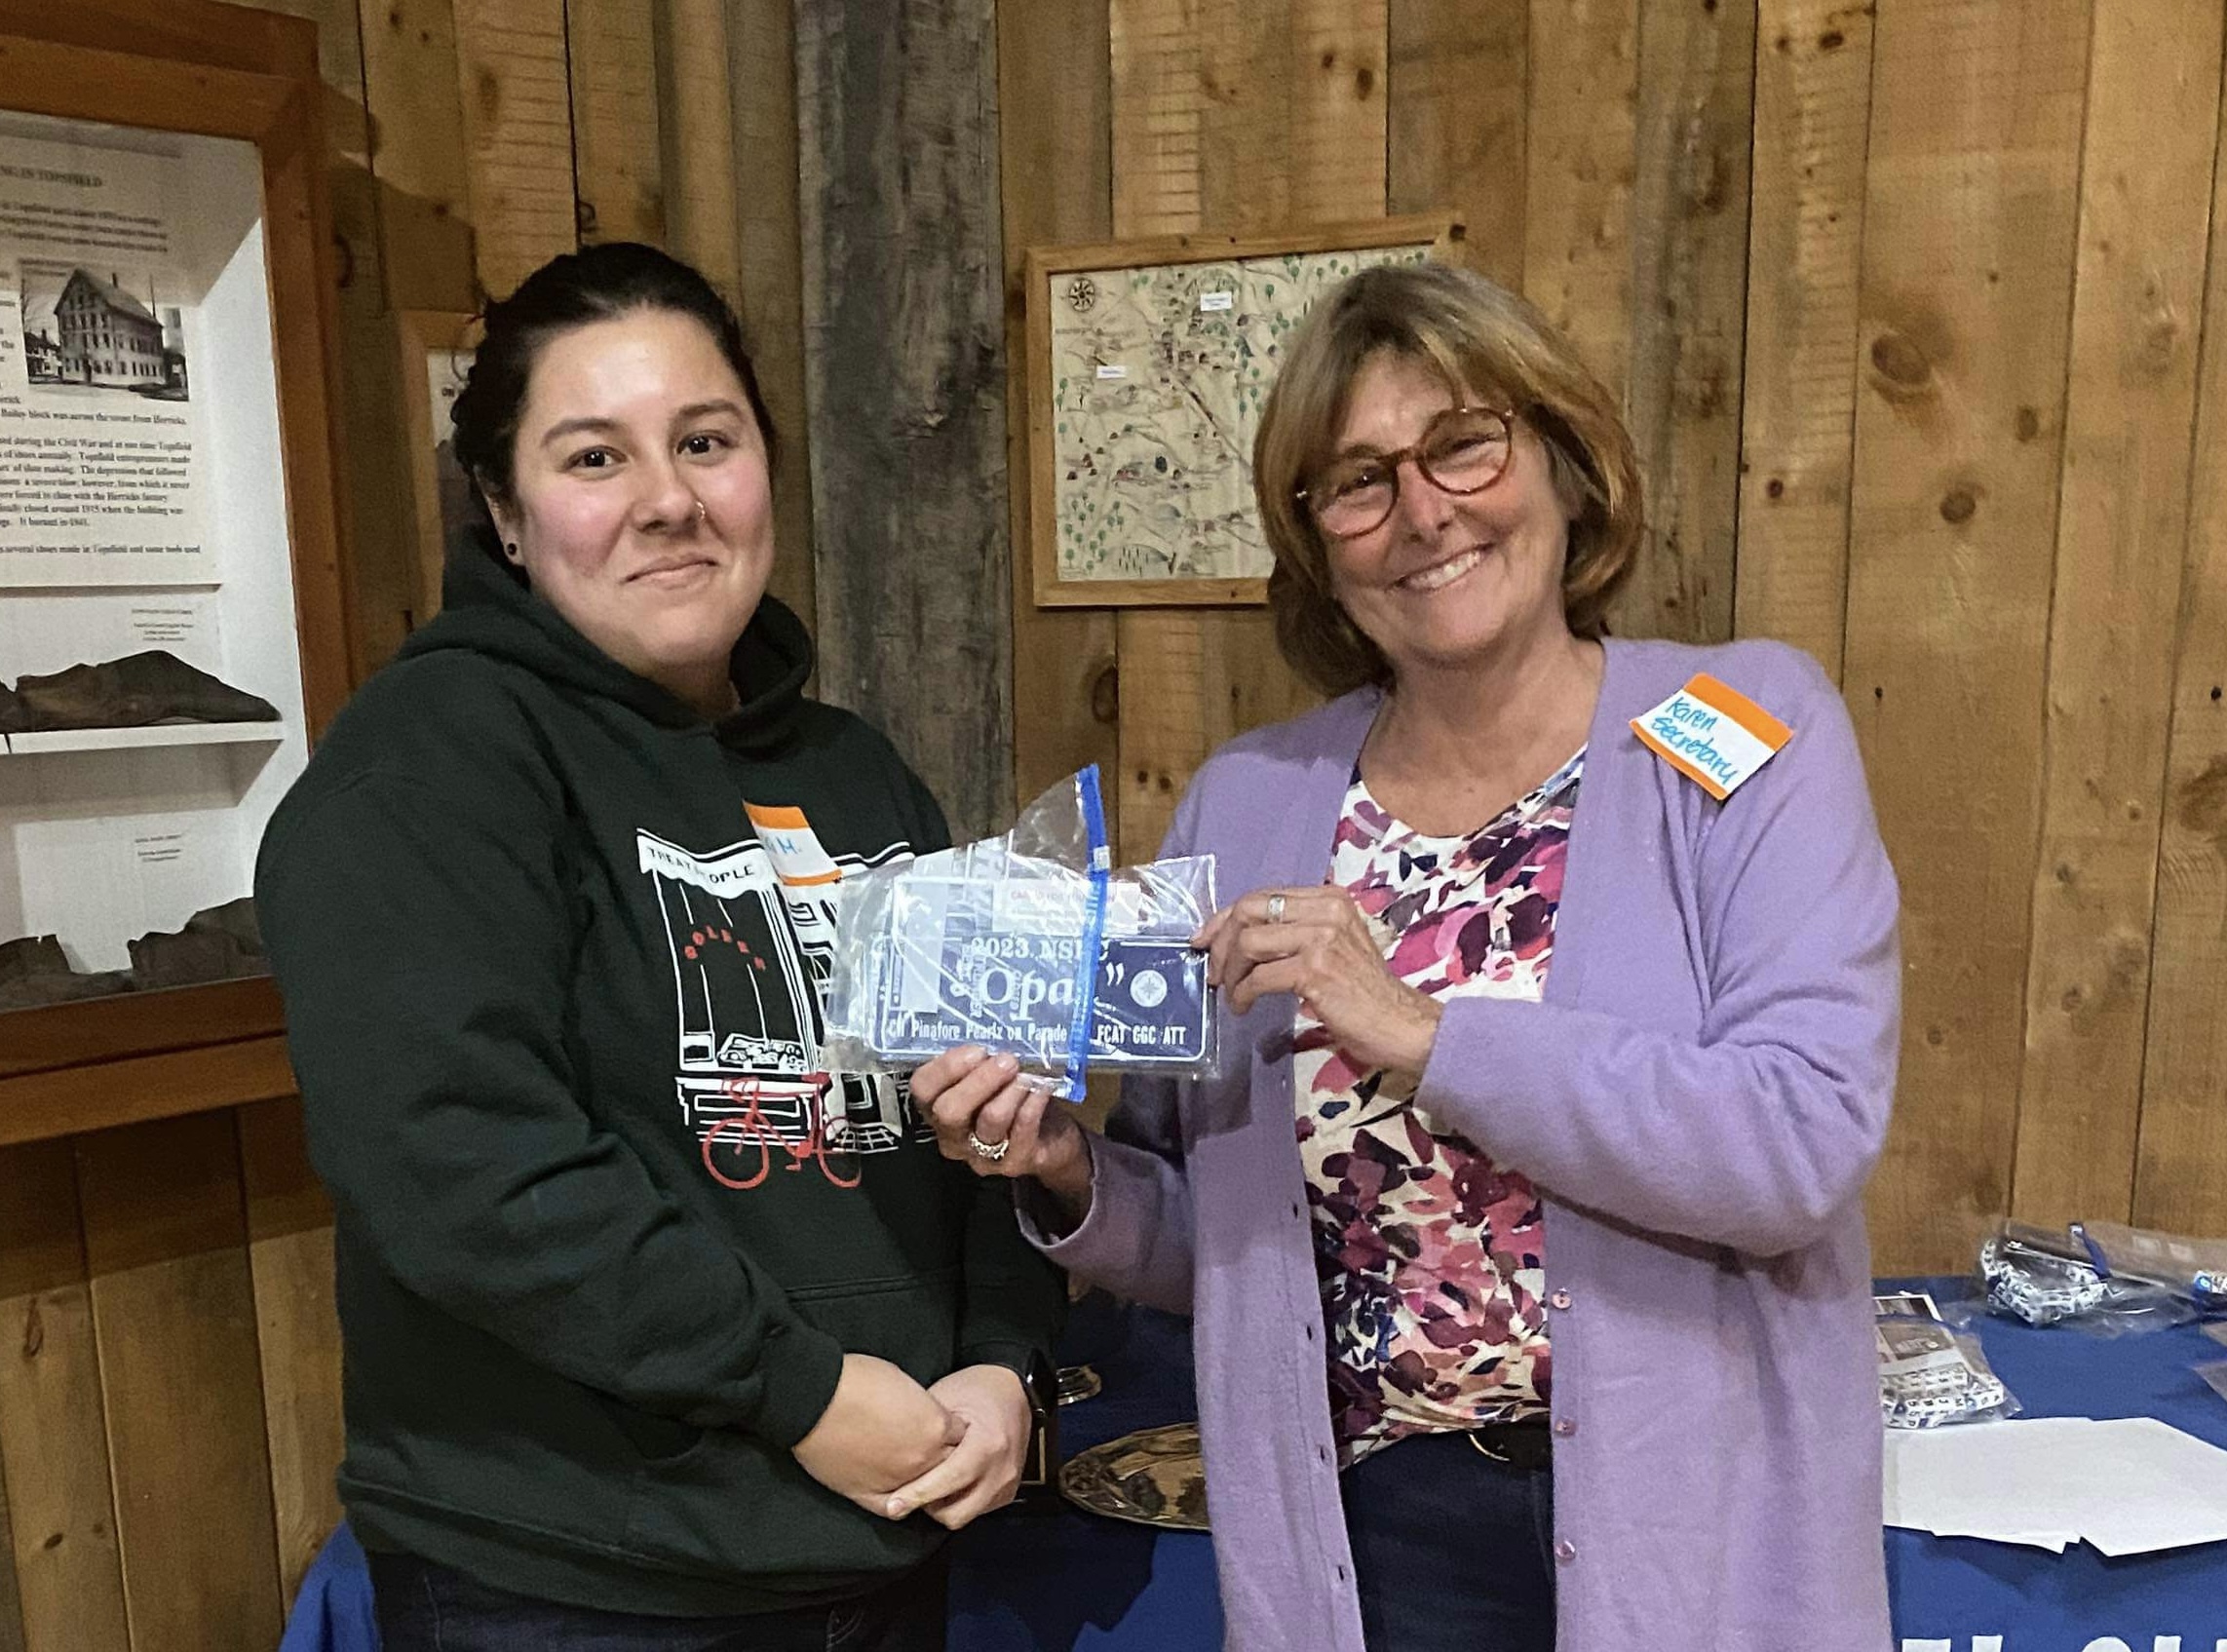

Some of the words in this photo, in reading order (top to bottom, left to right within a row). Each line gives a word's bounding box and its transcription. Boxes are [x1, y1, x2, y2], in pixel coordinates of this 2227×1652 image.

[1666, 696, 1718, 733] Karen
[647, 846, 692, 870] TREAT
[971, 937, 1031, 959] 2023
[910, 1019, 961, 1042] Pinafore
[1027, 1022, 1068, 1042] Parade
[1162, 1025, 1187, 1046] ATT
